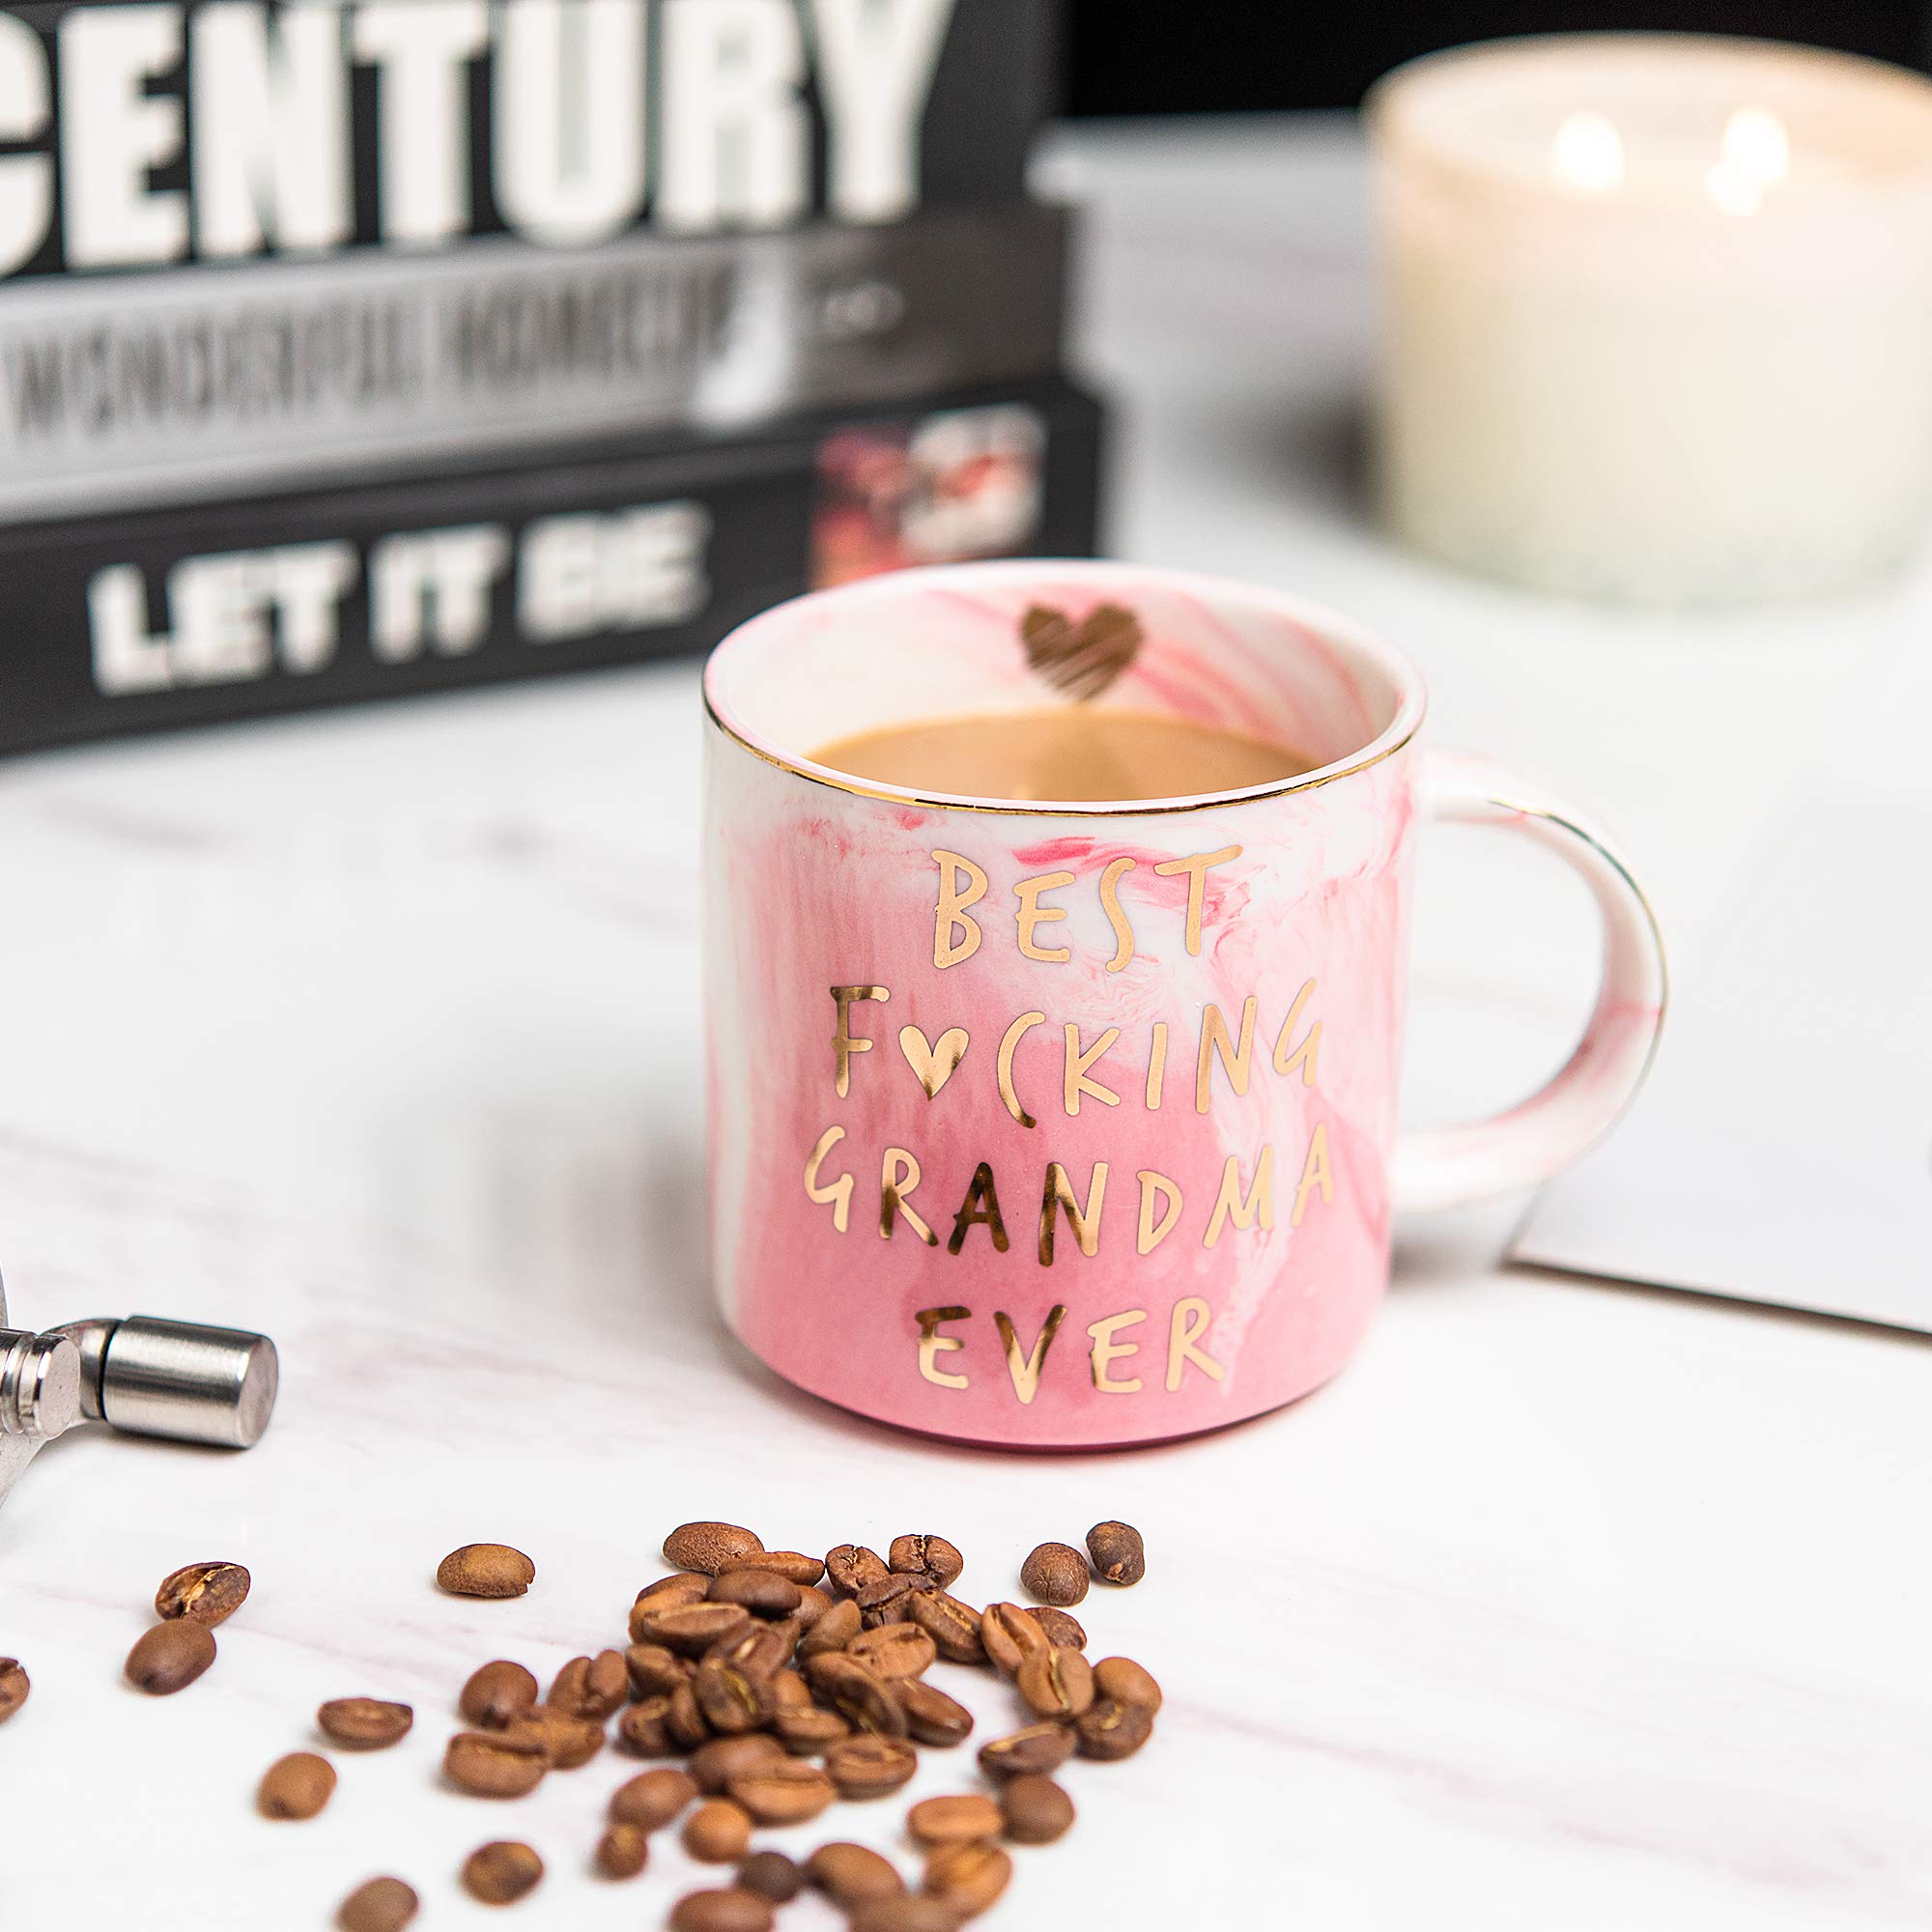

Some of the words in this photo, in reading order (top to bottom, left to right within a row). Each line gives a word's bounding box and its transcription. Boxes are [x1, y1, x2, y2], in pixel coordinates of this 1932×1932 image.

[89, 539, 361, 696] LET
[369, 522, 512, 665] IT
[516, 498, 713, 644] BE
[930, 844, 1243, 973] BEST
[803, 1122, 1333, 1267] GRANDMA
[916, 1296, 1226, 1405] EVER
